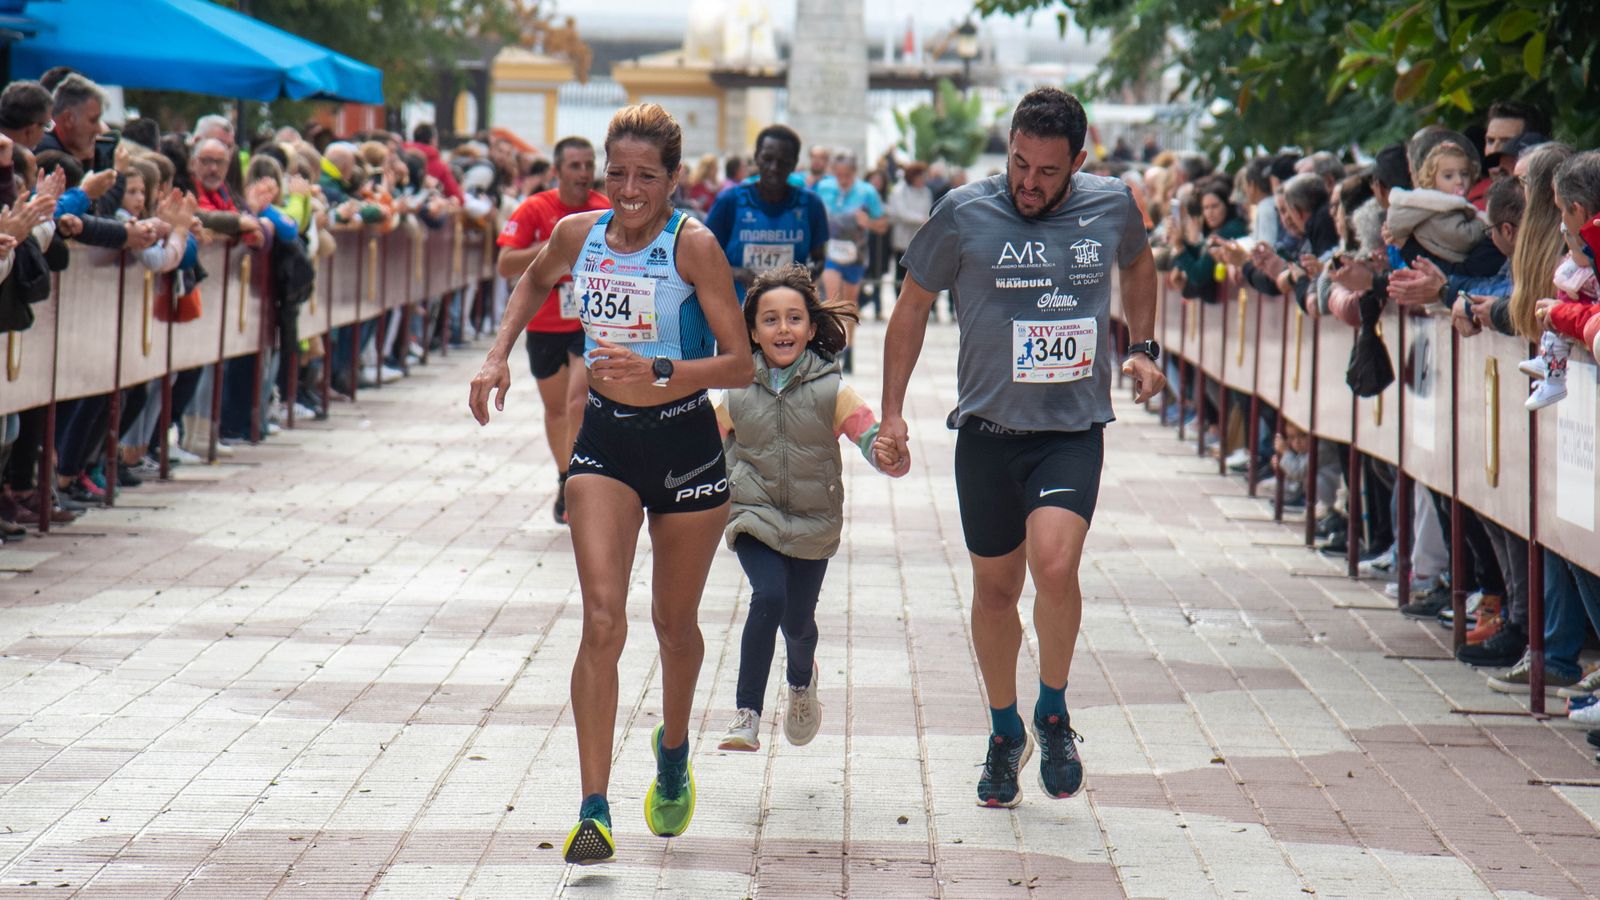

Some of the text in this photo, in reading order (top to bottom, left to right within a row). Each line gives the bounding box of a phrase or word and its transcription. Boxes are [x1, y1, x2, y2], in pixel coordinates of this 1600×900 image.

[740, 229, 803, 242] MARBELLA
[757, 253, 781, 267] 147
[587, 277, 611, 292] XIV
[611, 280, 636, 288] CARRERA
[995, 278, 1053, 289] MANDUKA
[621, 287, 651, 296] ESTRECHO
[590, 291, 632, 320] 354
[1028, 325, 1055, 337] XIV
[1067, 328, 1094, 337] ESTRECHO
[1035, 336, 1077, 361] 340
[660, 399, 697, 420] NIKE
[675, 478, 728, 502] PRO
